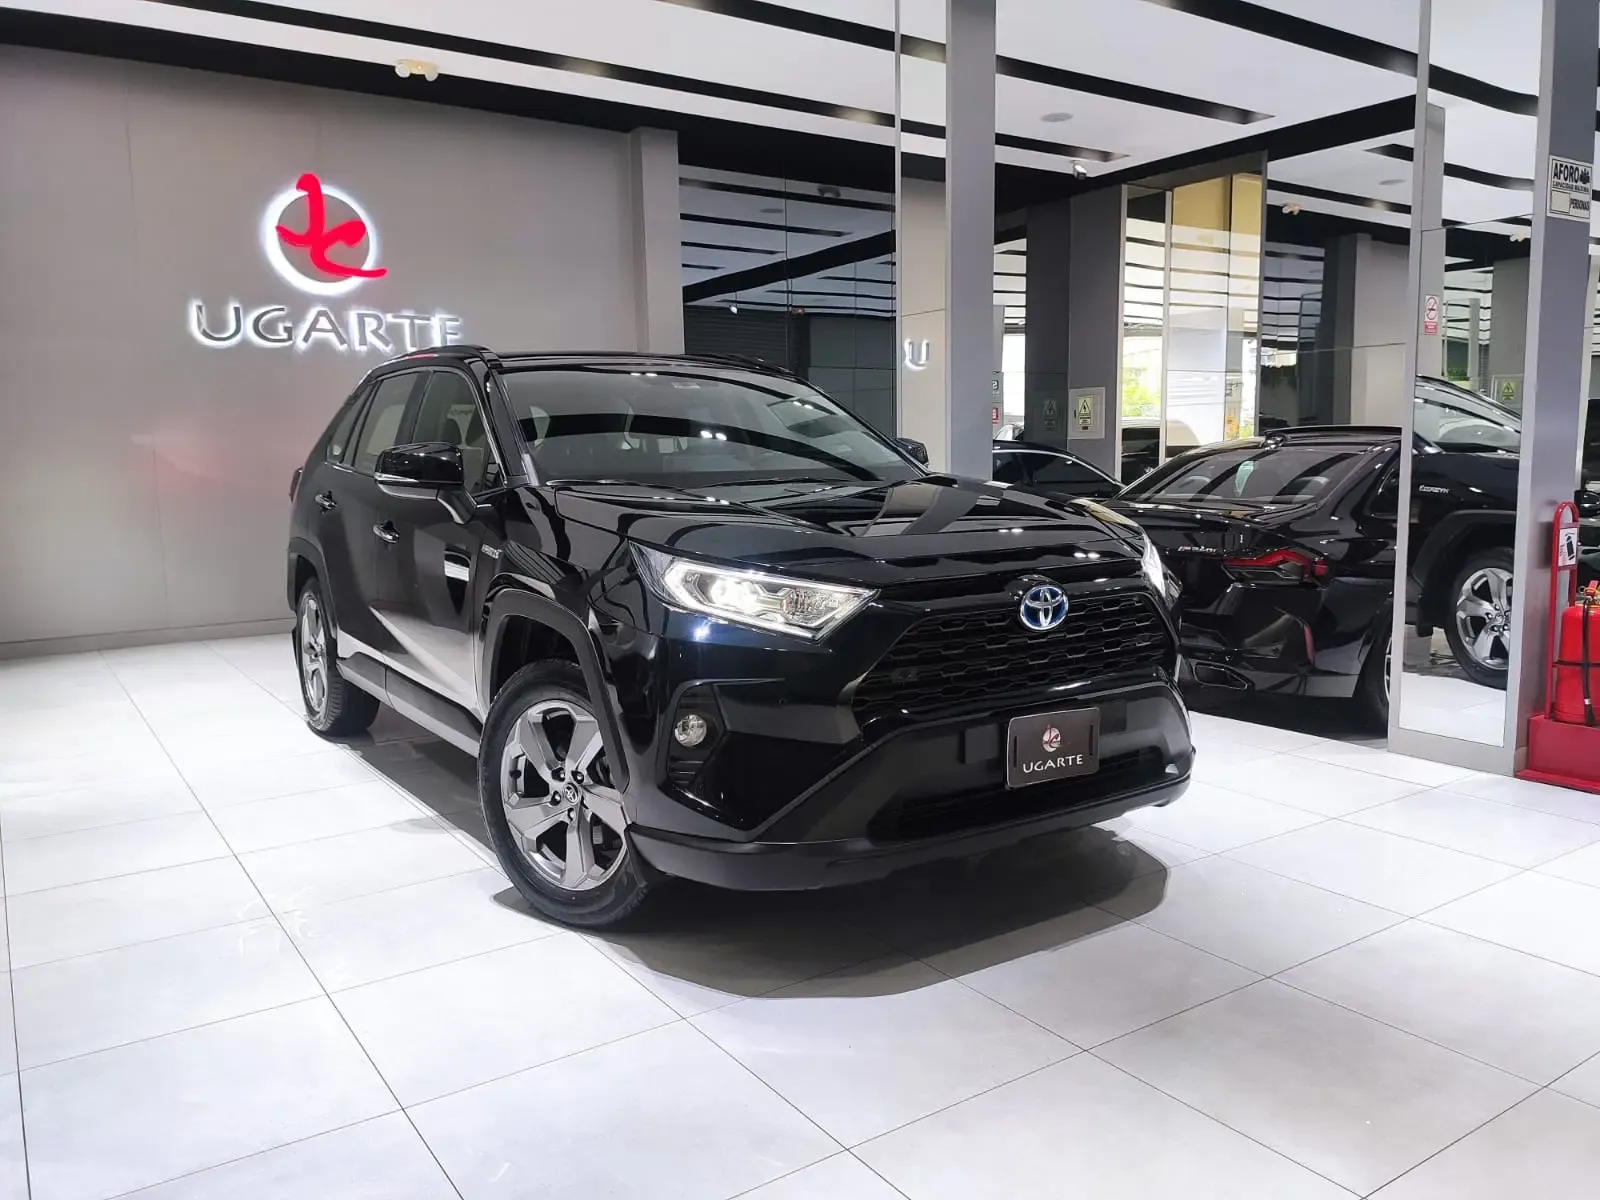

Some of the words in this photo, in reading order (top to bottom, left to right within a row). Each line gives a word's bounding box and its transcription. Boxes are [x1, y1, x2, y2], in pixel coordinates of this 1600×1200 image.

[1553, 162, 1580, 183] AFORO
[189, 299, 462, 353] UGARTE
[1022, 754, 1084, 774] UGARTE
